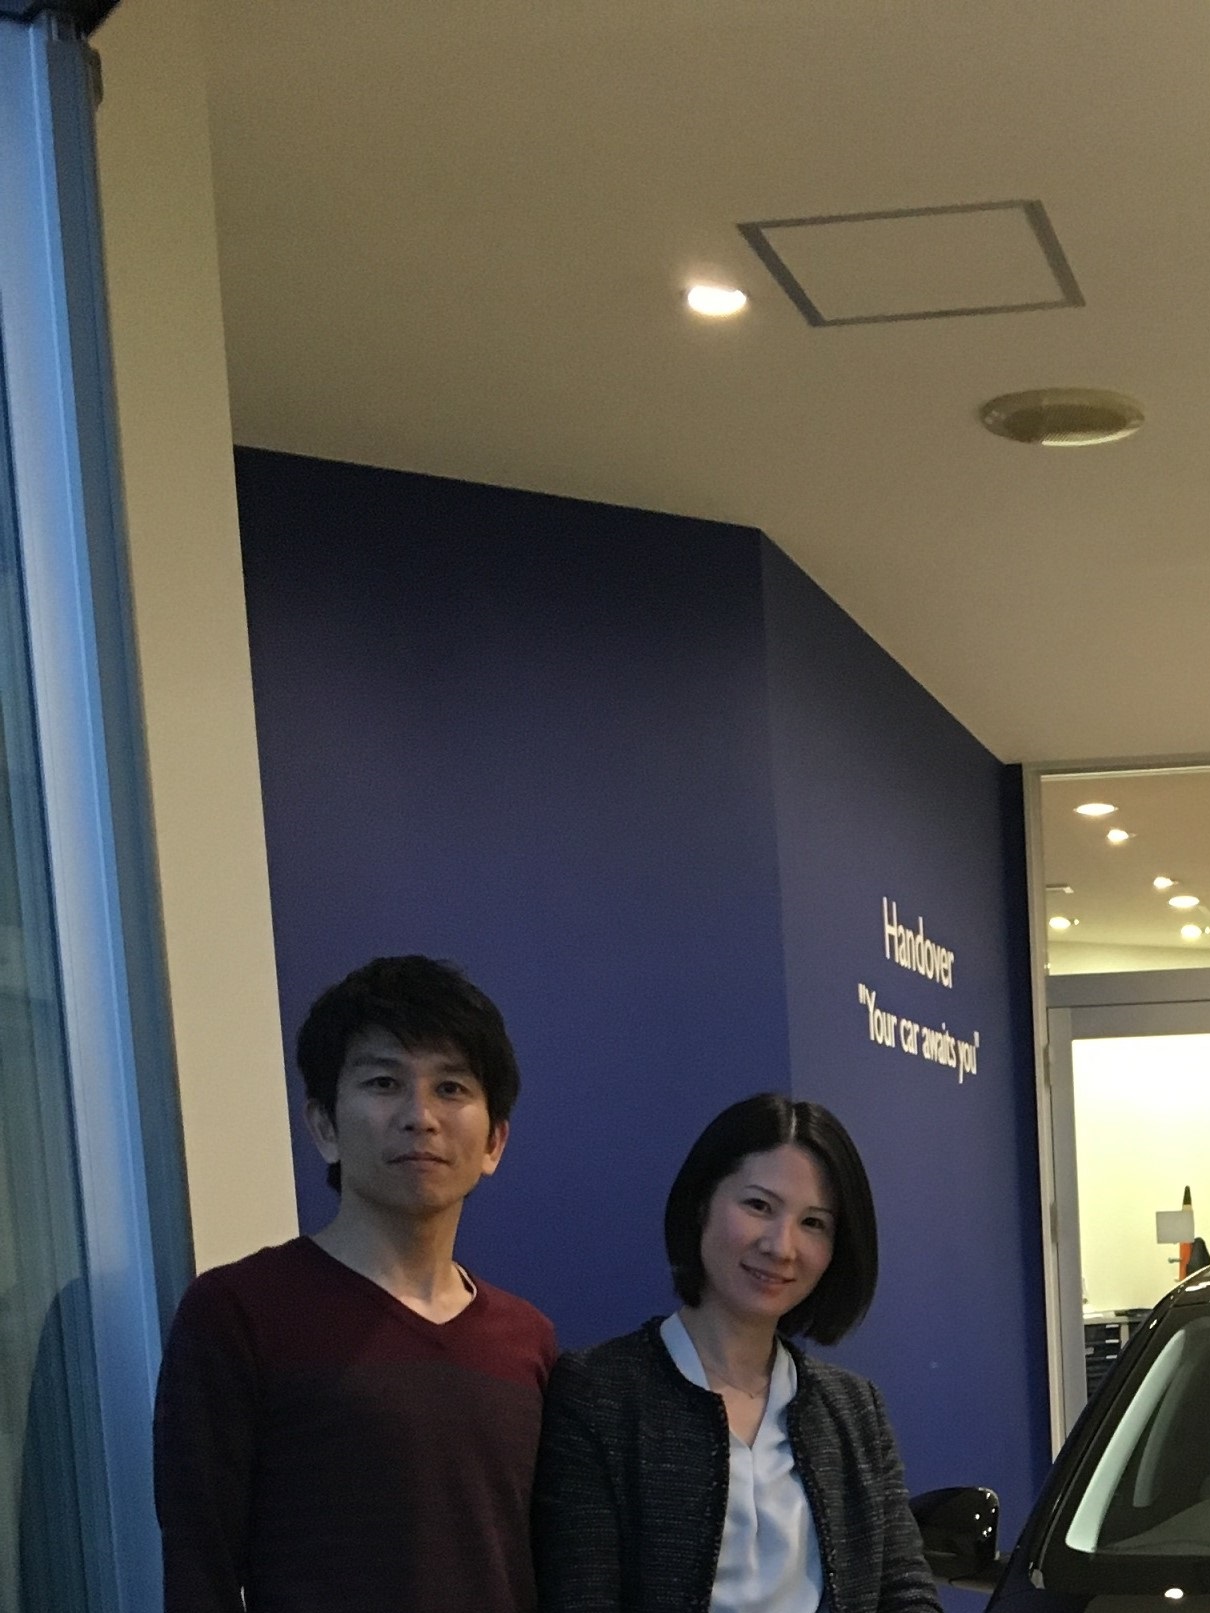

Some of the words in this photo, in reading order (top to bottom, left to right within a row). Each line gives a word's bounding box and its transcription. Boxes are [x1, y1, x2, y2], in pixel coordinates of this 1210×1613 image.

[882, 896, 955, 989] Handover
[857, 983, 897, 1048] "Your
[900, 1018, 919, 1056] car
[921, 1022, 957, 1069] awaits
